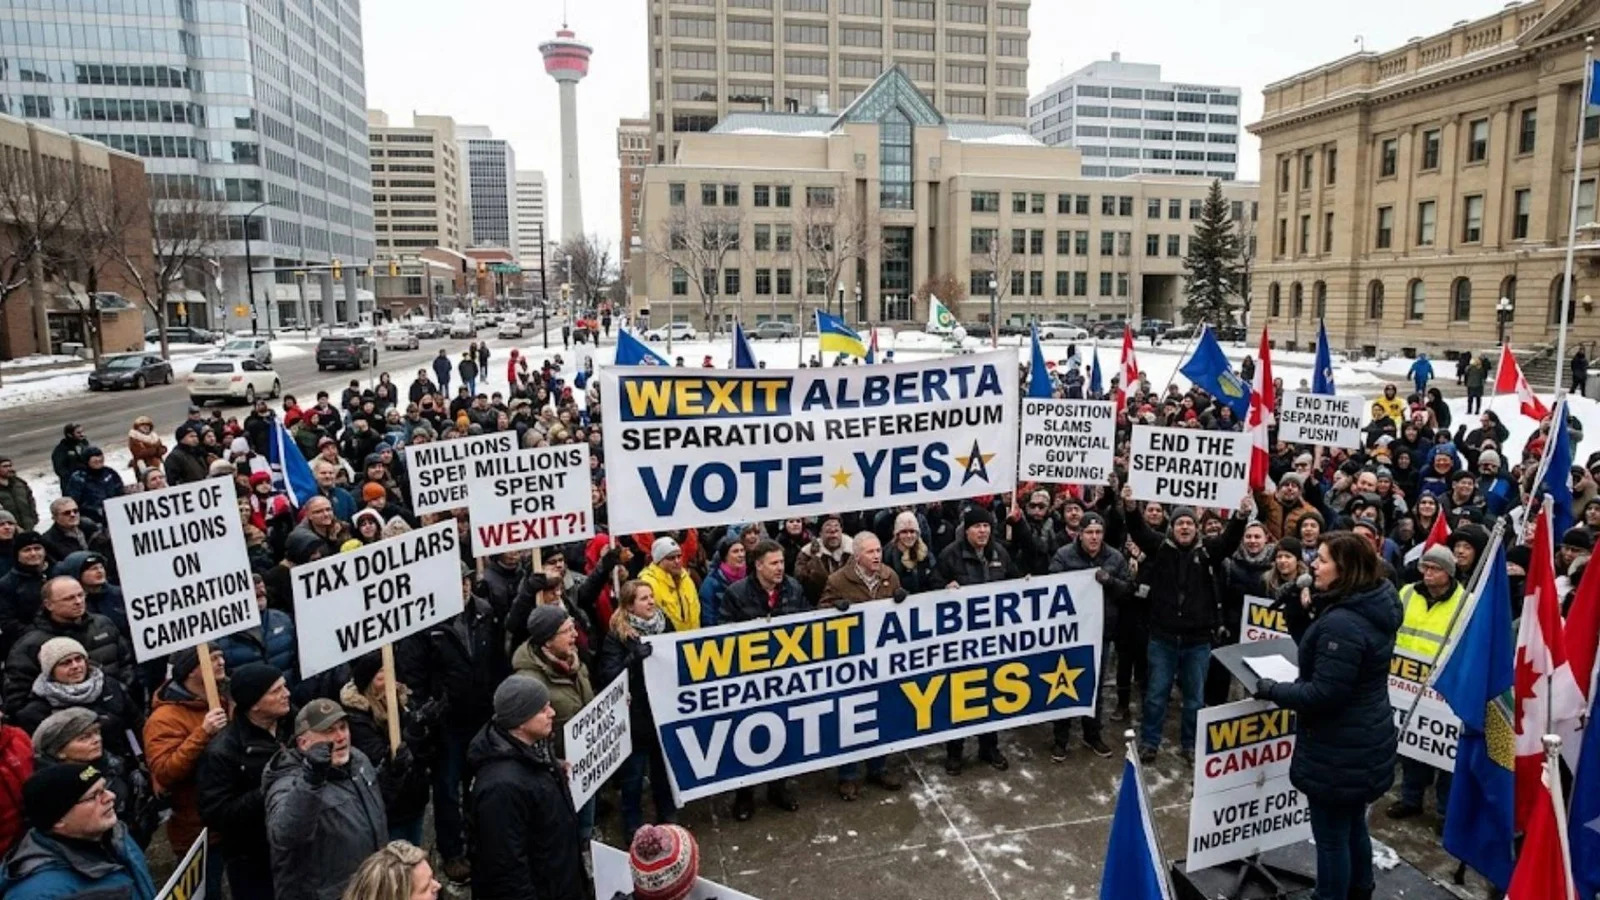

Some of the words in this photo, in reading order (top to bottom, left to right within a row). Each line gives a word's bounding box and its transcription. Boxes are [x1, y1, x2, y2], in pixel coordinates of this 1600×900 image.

[624, 379, 789, 417] WEXIT
[802, 364, 1002, 411] ALBERTA
[1296, 396, 1321, 410] END
[1326, 399, 1349, 413] THE
[621, 420, 815, 451] SEPARATION
[825, 404, 1002, 440] REFERENDUM
[1026, 403, 1112, 418] OPPOSITION
[1044, 419, 1092, 433] SLAMS
[1282, 411, 1360, 429] SEPARATION
[415, 436, 511, 467] MILLIONS
[1025, 433, 1109, 450] PROVINCIAL
[1150, 432, 1189, 452] END
[1196, 436, 1234, 456] THE
[1299, 427, 1338, 442] PUSH!
[475, 449, 582, 478] MILLIONS
[1028, 463, 1104, 479] SPENDING!
[1046, 449, 1088, 463] GOV'T
[1133, 454, 1246, 480] SEPARATION
[494, 472, 567, 496] SPENT
[637, 455, 823, 517] VOTE
[853, 442, 950, 498] YES
[1156, 477, 1217, 500] PUSH!
[124, 491, 194, 525] WASTE
[199, 485, 222, 510] OF
[510, 494, 555, 515] FOR
[132, 515, 227, 556] MILLIONS
[478, 511, 586, 548] WEXIT?!
[173, 551, 201, 578] ON
[298, 561, 349, 600] TAX
[354, 528, 454, 581] DOLLARS
[131, 569, 250, 621] SEPARATION
[363, 573, 411, 611] FOR
[143, 598, 251, 650] CAMPAIGN!
[335, 593, 436, 653] WEXIT?!
[682, 616, 860, 682] WEXIT
[877, 584, 1077, 648] ALBERTA
[678, 657, 878, 714] SEPARATION
[890, 622, 1079, 675] REFERENDUM
[676, 691, 879, 781] VOTE
[900, 662, 1031, 731] YES
[1209, 708, 1293, 751] WEXI
[1418, 715, 1458, 740] FOR
[1213, 799, 1259, 827] VOTE
[1265, 790, 1298, 814] FOR
[1193, 807, 1312, 853] INDEPENDENCE
